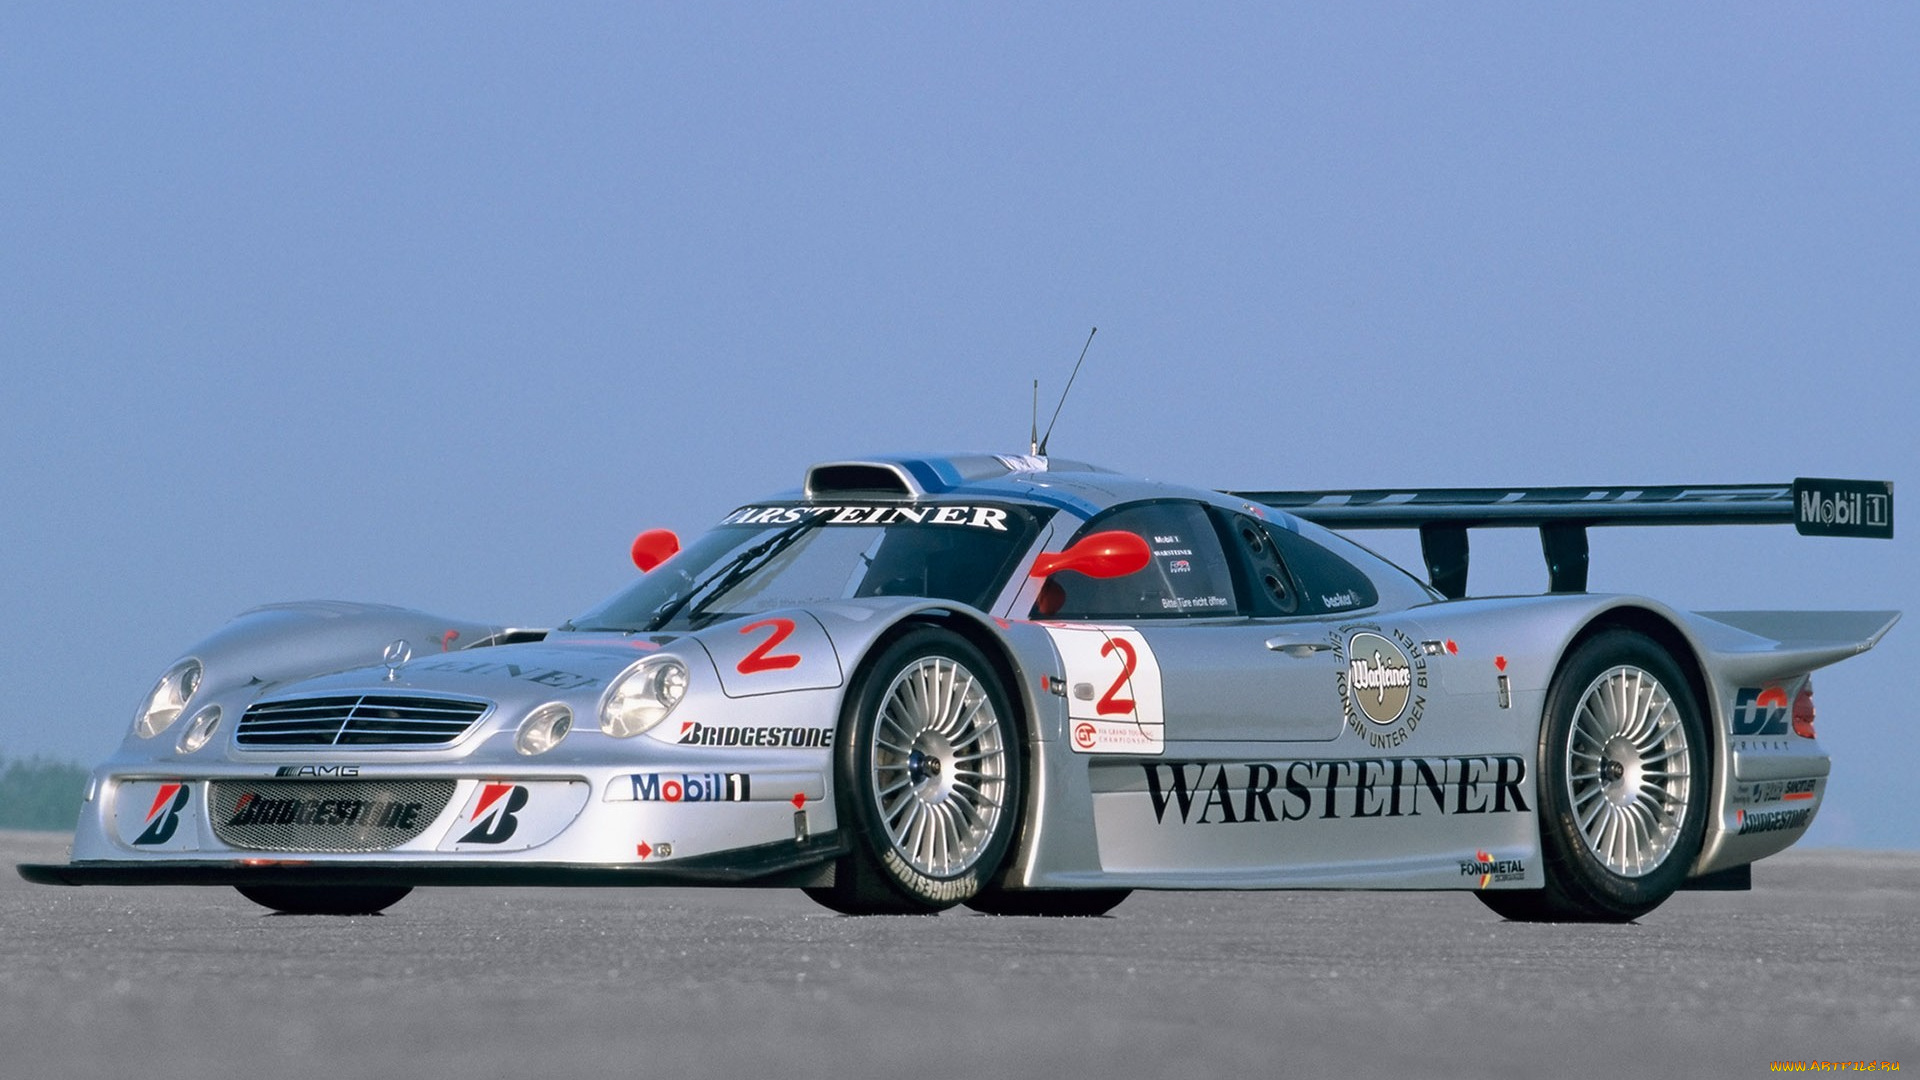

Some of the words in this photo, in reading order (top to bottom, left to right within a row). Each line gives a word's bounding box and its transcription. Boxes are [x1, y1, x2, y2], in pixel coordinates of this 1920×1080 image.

[1801, 490, 1861, 526] Mobil
[1193, 596, 1208, 606] nicht
[1208, 595, 1228, 606] öffnen
[737, 617, 801, 675] 2
[1393, 628, 1428, 689] BIEREN
[1096, 637, 1137, 716] 2
[1406, 695, 1426, 731] DEN
[1733, 687, 1788, 735] D2
[678, 721, 833, 747] BRIDGESTONE
[1369, 727, 1408, 749] UNTER
[299, 765, 360, 778] AMG
[630, 773, 721, 802] Mobil
[727, 774, 745, 801] 1
[1140, 756, 1531, 825] WARSTEINER
[1460, 860, 1525, 876] FONDMETAL
